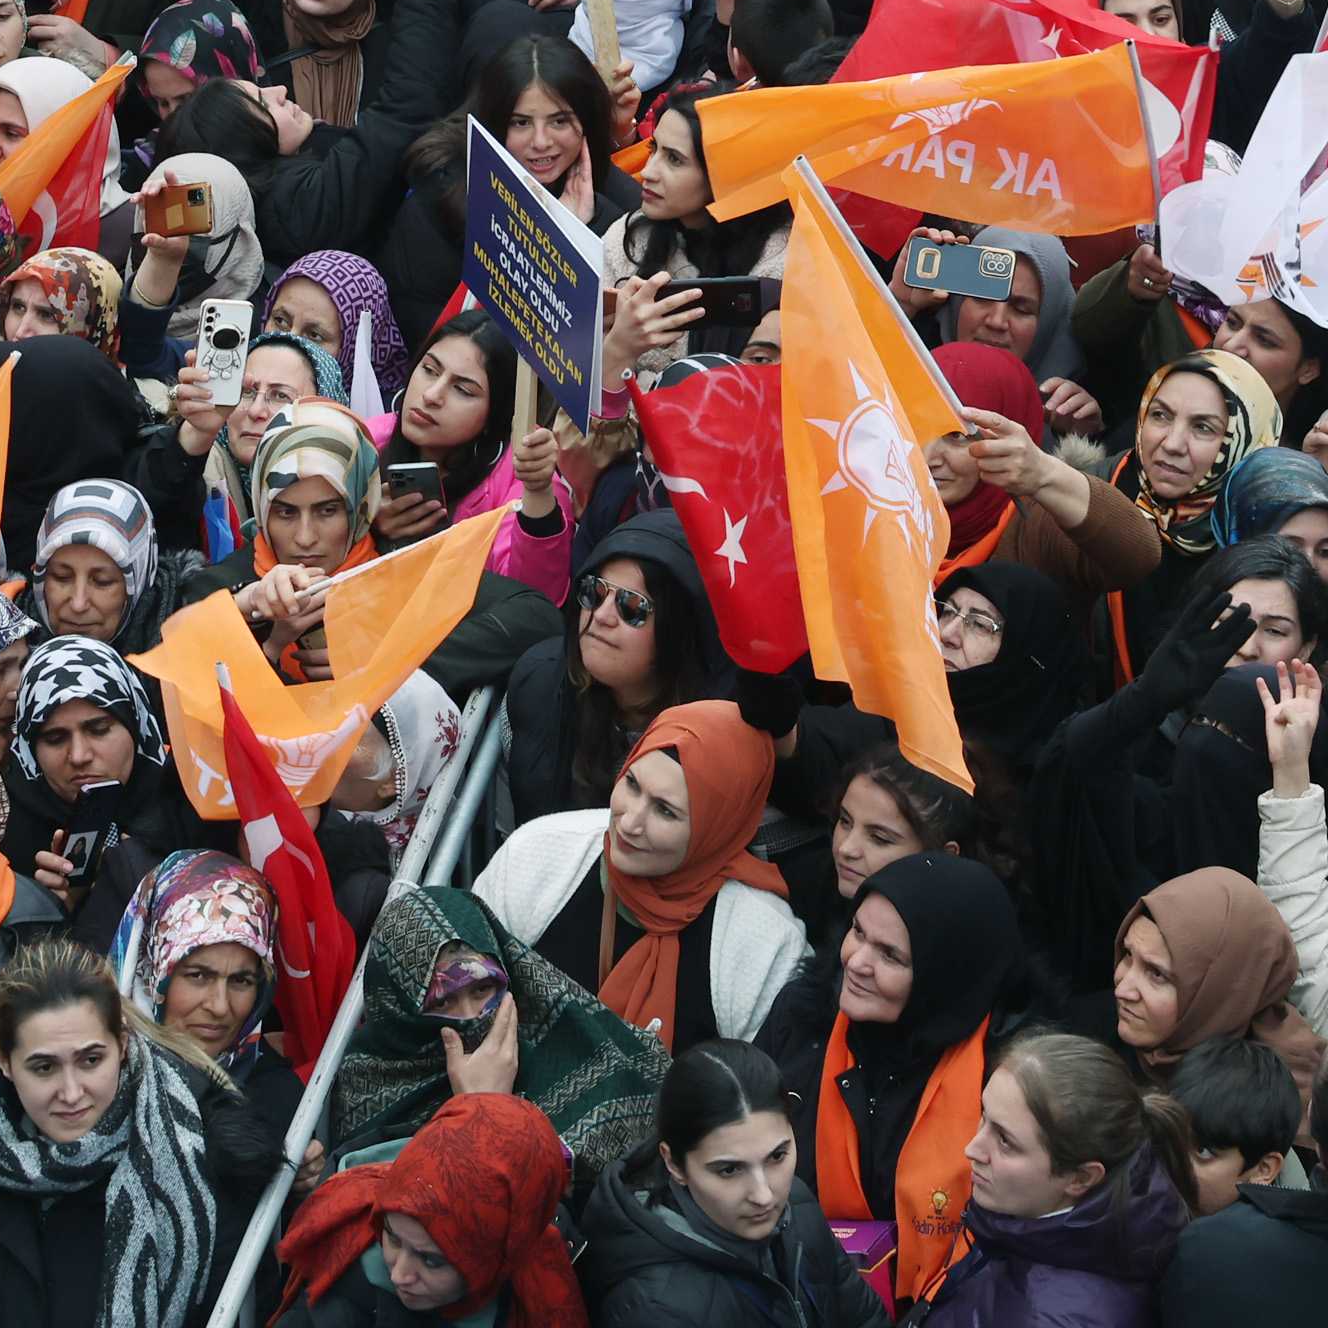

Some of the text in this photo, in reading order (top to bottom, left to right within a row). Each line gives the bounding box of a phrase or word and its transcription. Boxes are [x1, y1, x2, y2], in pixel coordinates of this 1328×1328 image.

[489, 170, 578, 289] VERİLEN SÖZLER
[490, 213, 573, 329] İCRAATLERİMİZ
[507, 214, 558, 285] TUTULDU
[473, 241, 584, 387] MUHALEFETE KALAN
[488, 277, 565, 385] İZLEMEK OLDU
[499, 251, 560, 333] OLAY OLDU
